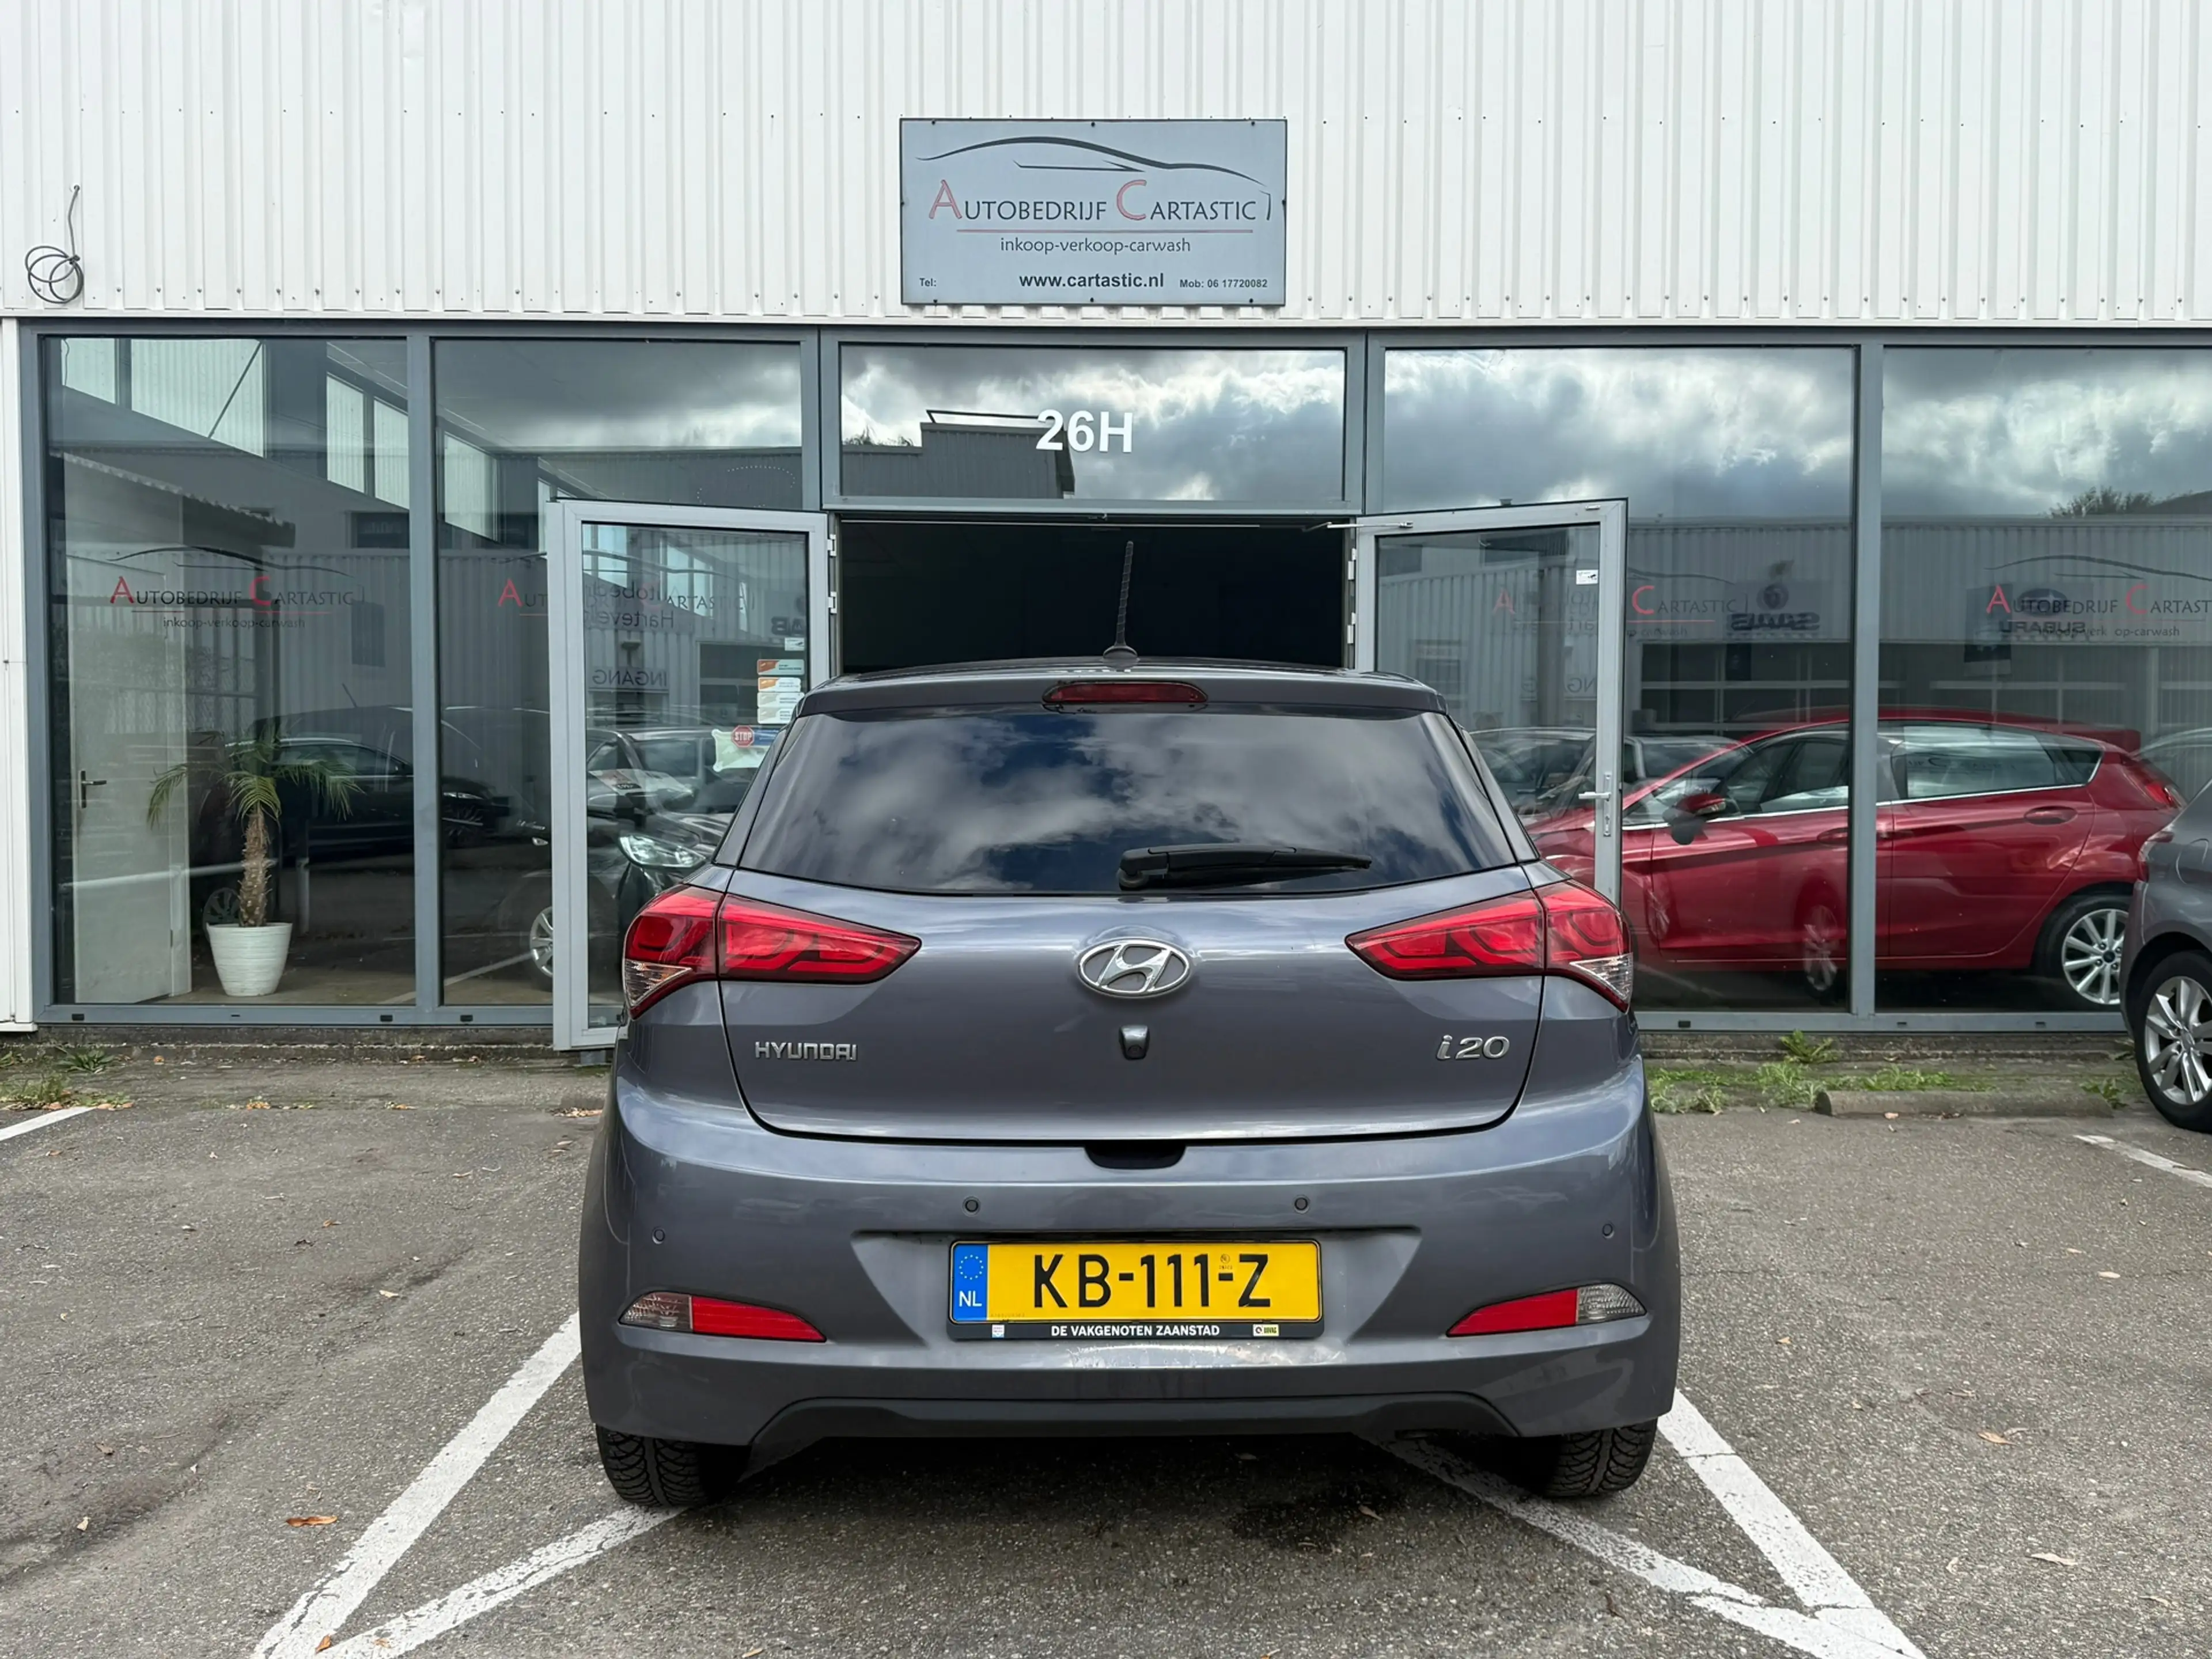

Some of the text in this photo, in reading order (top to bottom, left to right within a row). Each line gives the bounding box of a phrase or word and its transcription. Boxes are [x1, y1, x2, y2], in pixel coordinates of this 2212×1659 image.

[928, 179, 1256, 221] AUTOBEDRIJF CARTASTIC
[1000, 237, 1191, 255] inkoop-verkoop-carwash
[919, 278, 937, 287] Tel:
[1019, 273, 1164, 288] www.cartastic.nl
[1179, 279, 1268, 289] Mob: 06 17720082
[1035, 408, 1134, 453] 26H
[109, 575, 243, 605] AUTOBEDRIJF
[1631, 585, 1737, 615] CARTASTIC
[754, 1041, 857, 1062] HYUNDAI
[1436, 1033, 1510, 1060] i20
[1034, 1253, 1271, 1308] KB-111-Z
[959, 1291, 982, 1307] NL
[1051, 1325, 1220, 1336] DE VAKGENOTEN ZAANSTAD
